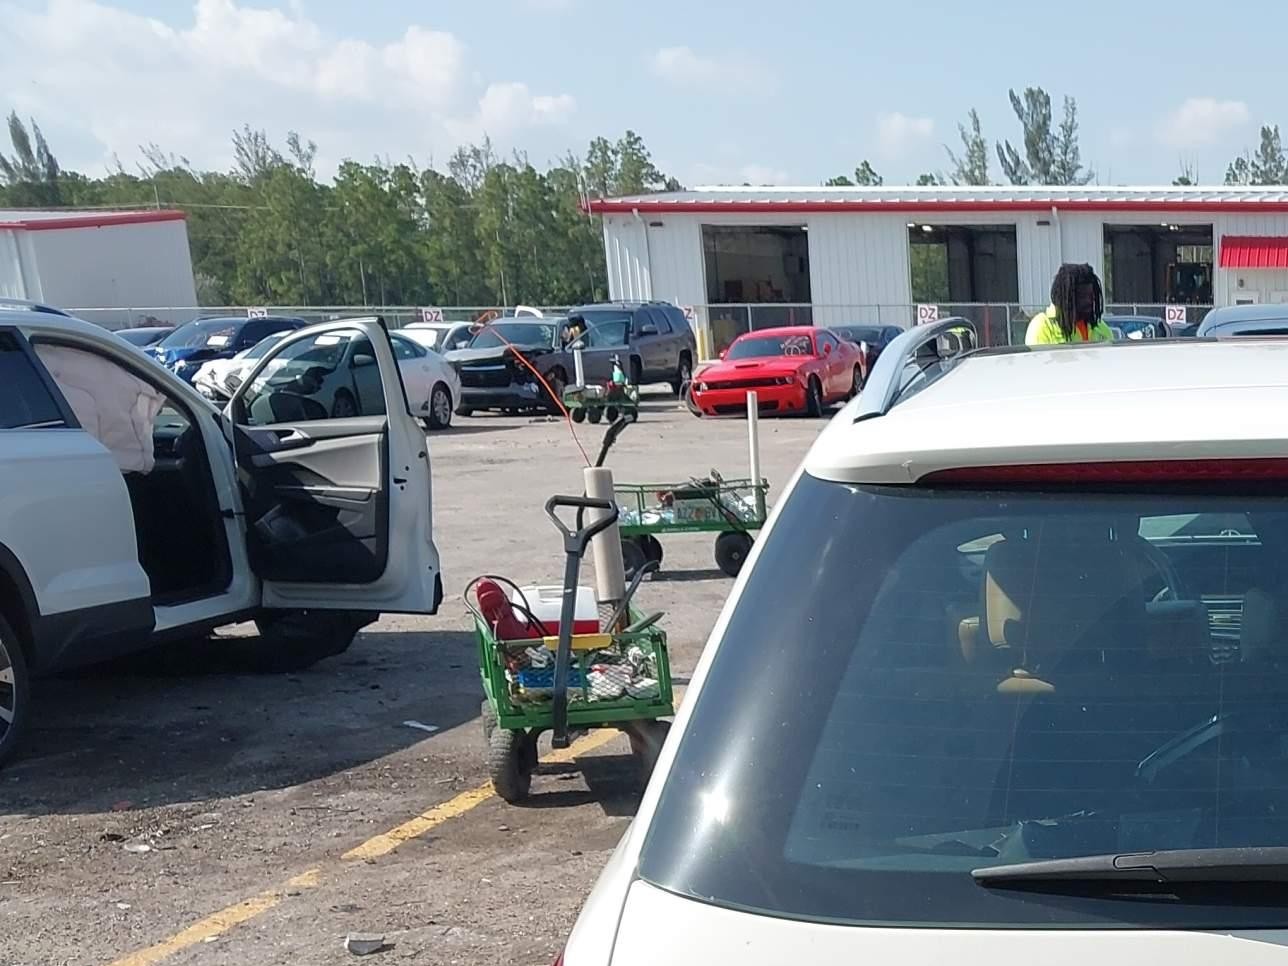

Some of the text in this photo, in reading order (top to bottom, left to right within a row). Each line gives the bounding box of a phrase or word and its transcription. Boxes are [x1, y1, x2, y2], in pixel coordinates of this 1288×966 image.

[424, 310, 440, 321] DZ
[920, 307, 935, 319] DZ
[1167, 308, 1184, 320] DZ
